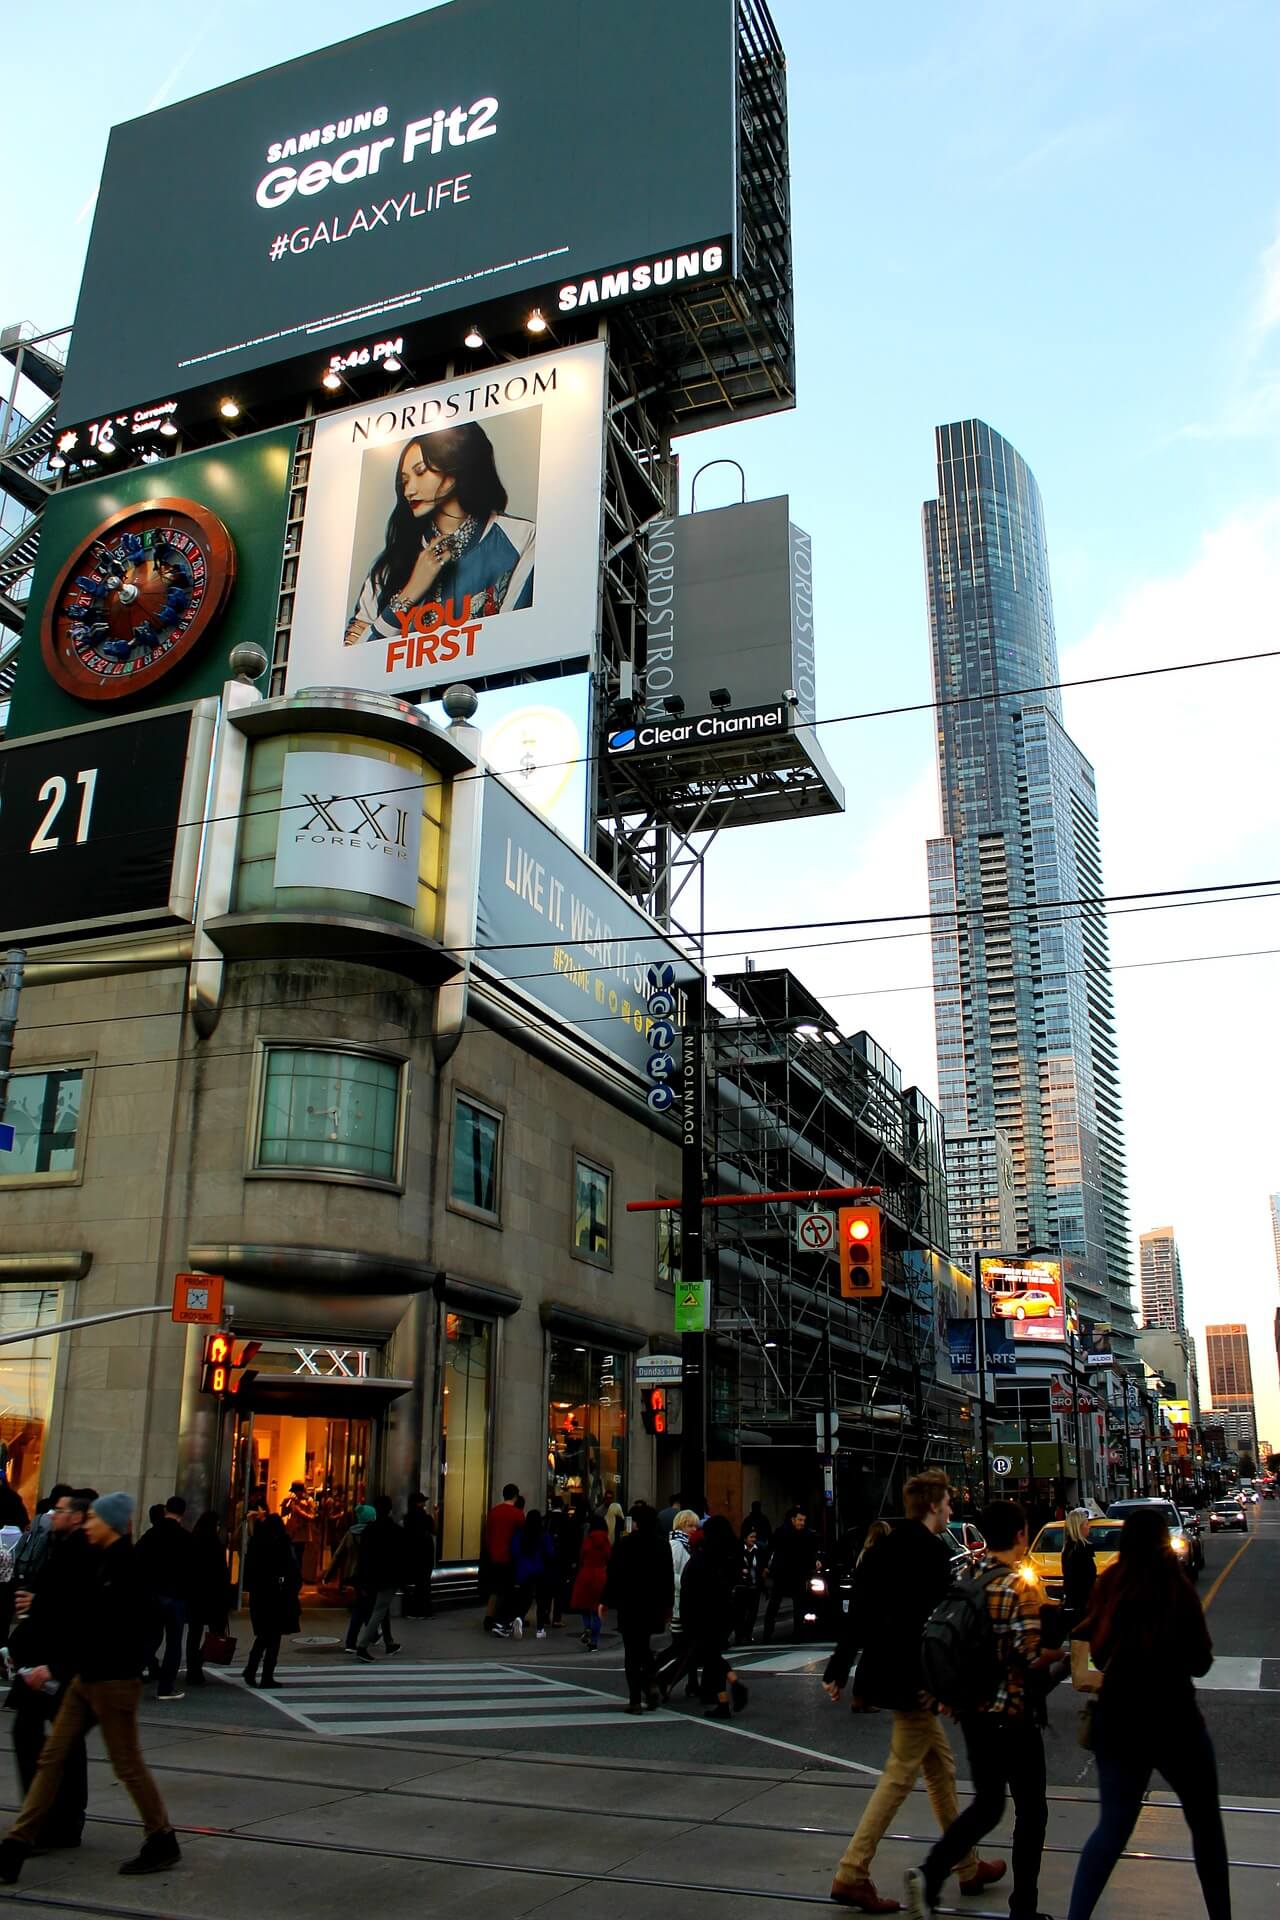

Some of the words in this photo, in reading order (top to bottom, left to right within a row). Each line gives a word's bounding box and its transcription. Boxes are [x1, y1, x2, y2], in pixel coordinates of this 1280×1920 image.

[256, 137, 396, 209] Gear
[403, 97, 499, 164] Fit2
[267, 106, 389, 163] SAMSUNG
[269, 173, 472, 261] #GALAXYLIFE
[558, 246, 723, 311] SAMSUNG
[329, 349, 370, 373] 5:46
[373, 338, 404, 361] PM
[88, 419, 114, 446] 16
[134, 401, 178, 422] Currently
[351, 367, 558, 443] NORDSTROM
[394, 594, 472, 639] YOU
[646, 519, 675, 720] NORDSTROM
[386, 623, 483, 673] FIRST
[639, 725, 693, 746] Clear
[696, 707, 782, 736] Channel
[29, 768, 98, 854] 21
[298, 792, 409, 847] XXI
[295, 834, 408, 860] FOREVER
[504, 837, 545, 915] LIKE
[549, 875, 564, 932] IT.
[571, 893, 612, 970] WEAR
[647, 962, 675, 1113] Yonge
[684, 1035, 695, 1145] DOWNTOWN
[292, 1347, 368, 1378] XXI
[639, 1367, 665, 1376] Dundas
[950, 1353, 972, 1364] THE
[985, 1353, 1017, 1364] ARTS
